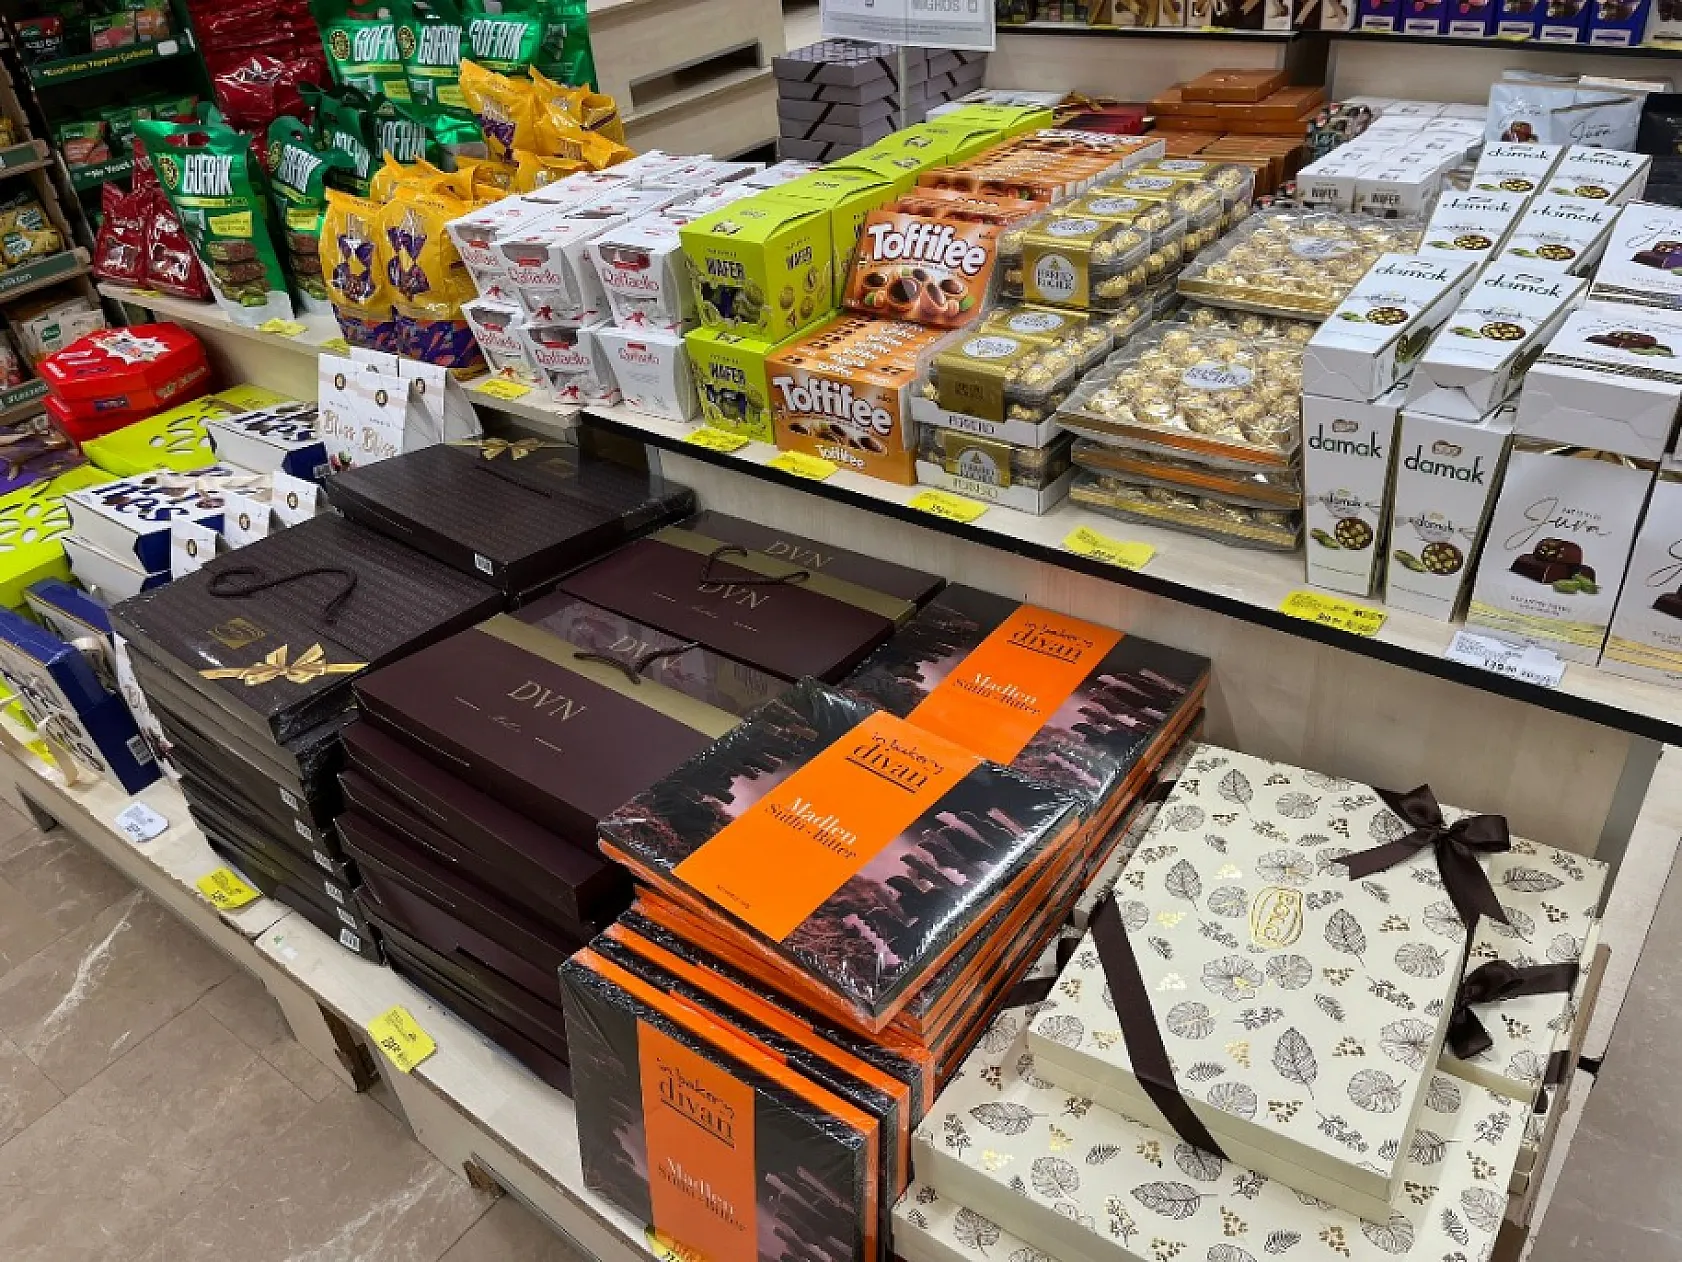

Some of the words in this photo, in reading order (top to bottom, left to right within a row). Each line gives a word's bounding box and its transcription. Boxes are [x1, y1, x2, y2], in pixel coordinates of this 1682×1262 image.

[868, 222, 987, 275] Toffifee
[772, 375, 894, 437] Toffifee
[1308, 422, 1383, 459] damak
[1403, 444, 1486, 485] damak
[762, 539, 835, 569] DVN
[1013, 628, 1083, 660] divan
[505, 679, 588, 723] DVN
[974, 672, 1037, 704] Madlen
[853, 743, 929, 788] divan
[789, 796, 857, 846] Madlen
[659, 1076, 734, 1140] divan
